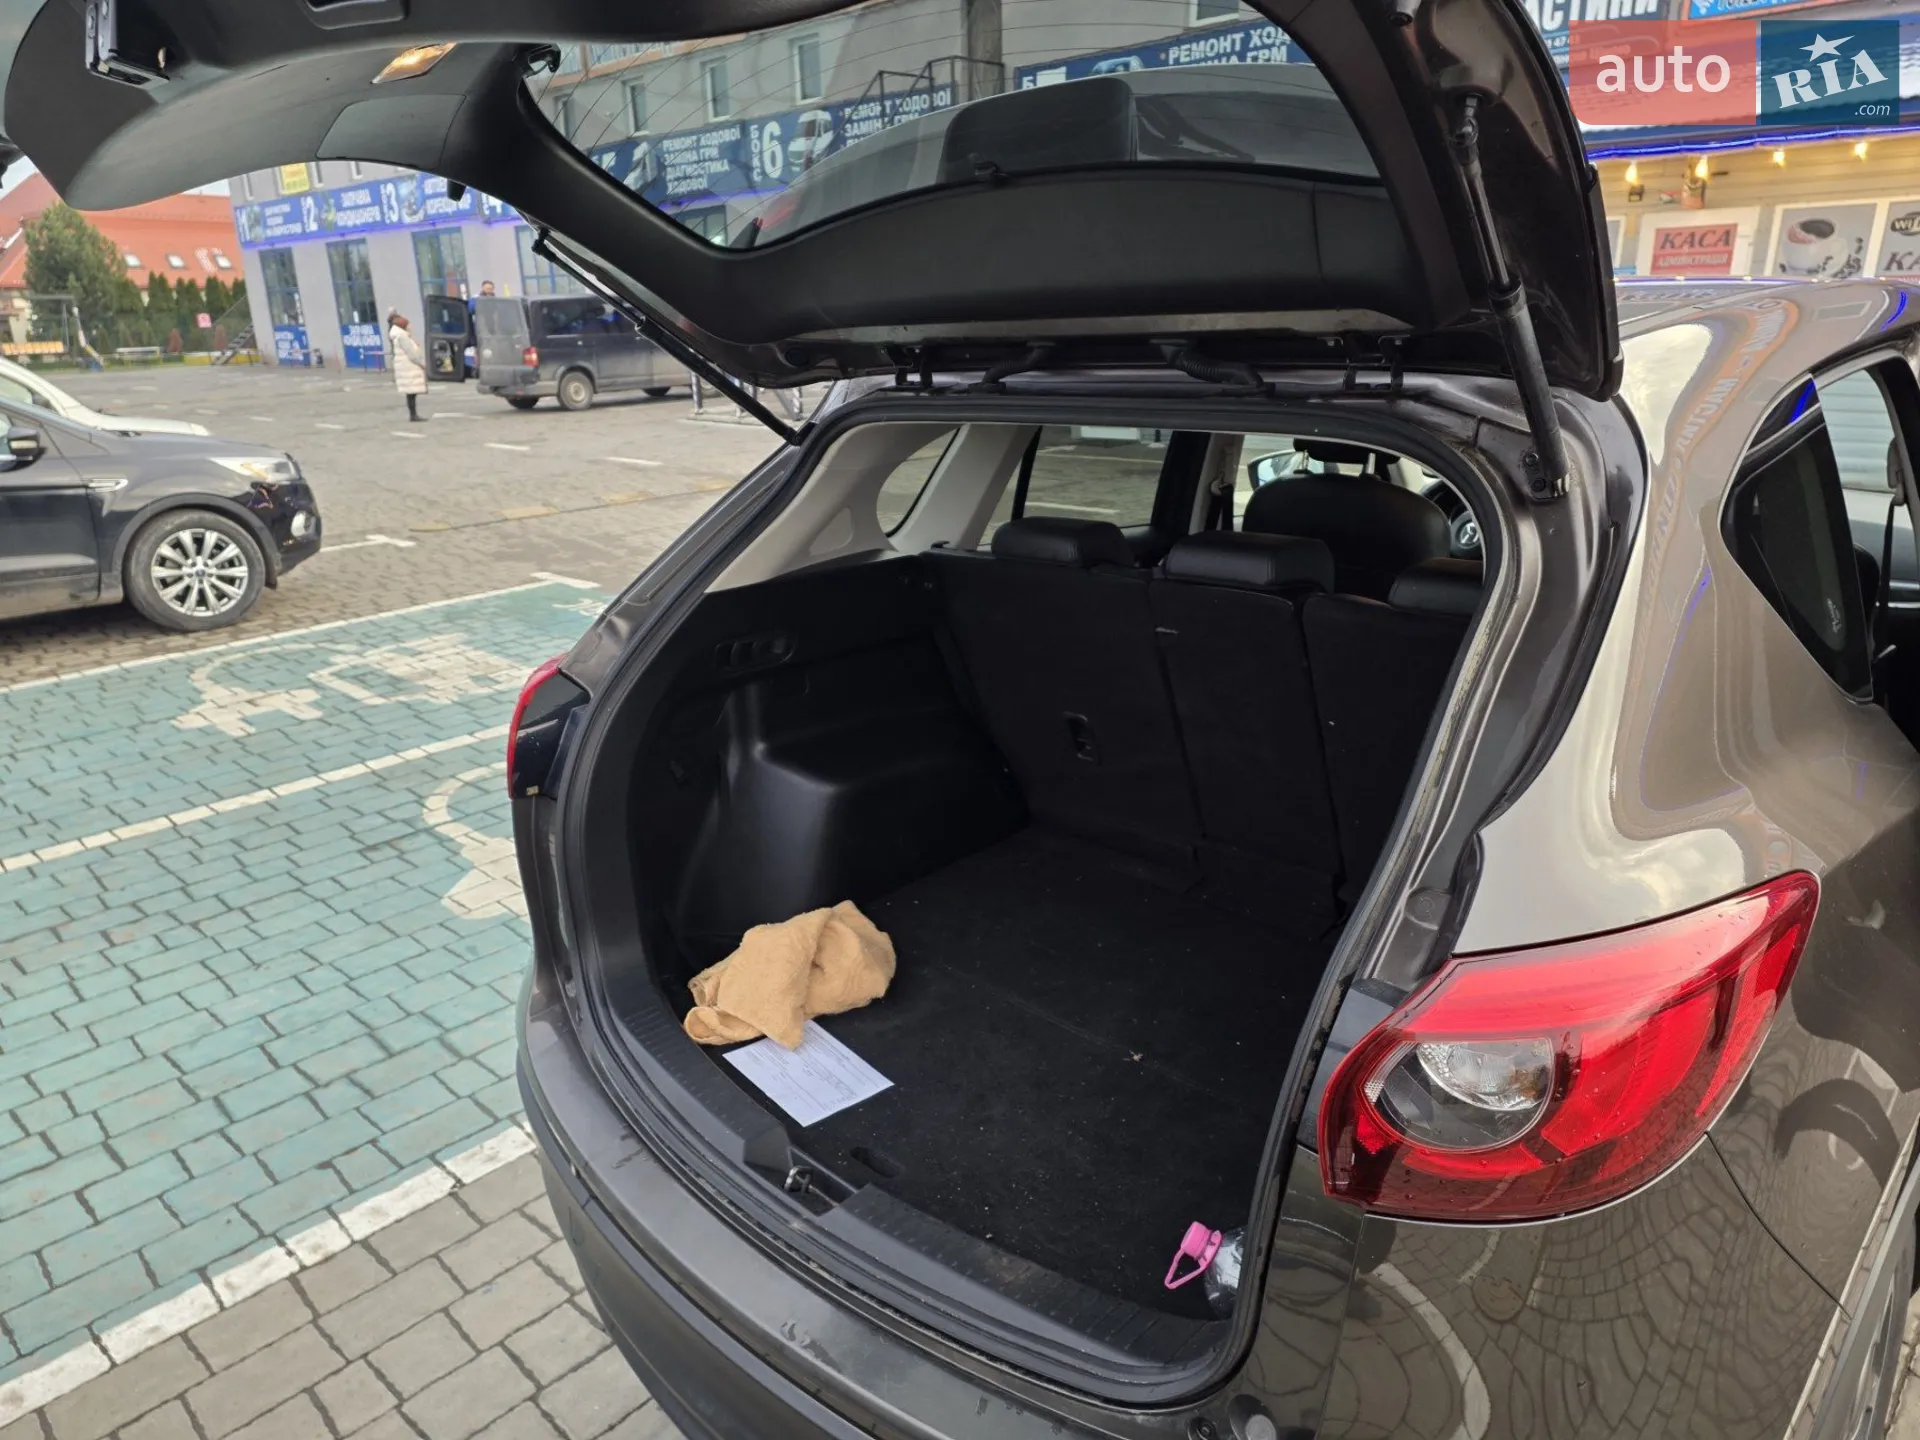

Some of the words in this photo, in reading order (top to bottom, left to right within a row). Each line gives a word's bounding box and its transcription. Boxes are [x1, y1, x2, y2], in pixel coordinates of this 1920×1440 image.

[1168, 33, 1245, 65] РЕМОНТ
[750, 125, 763, 182] БОКС
[762, 121, 783, 178] 6
[1659, 229, 1733, 250] КАСА
